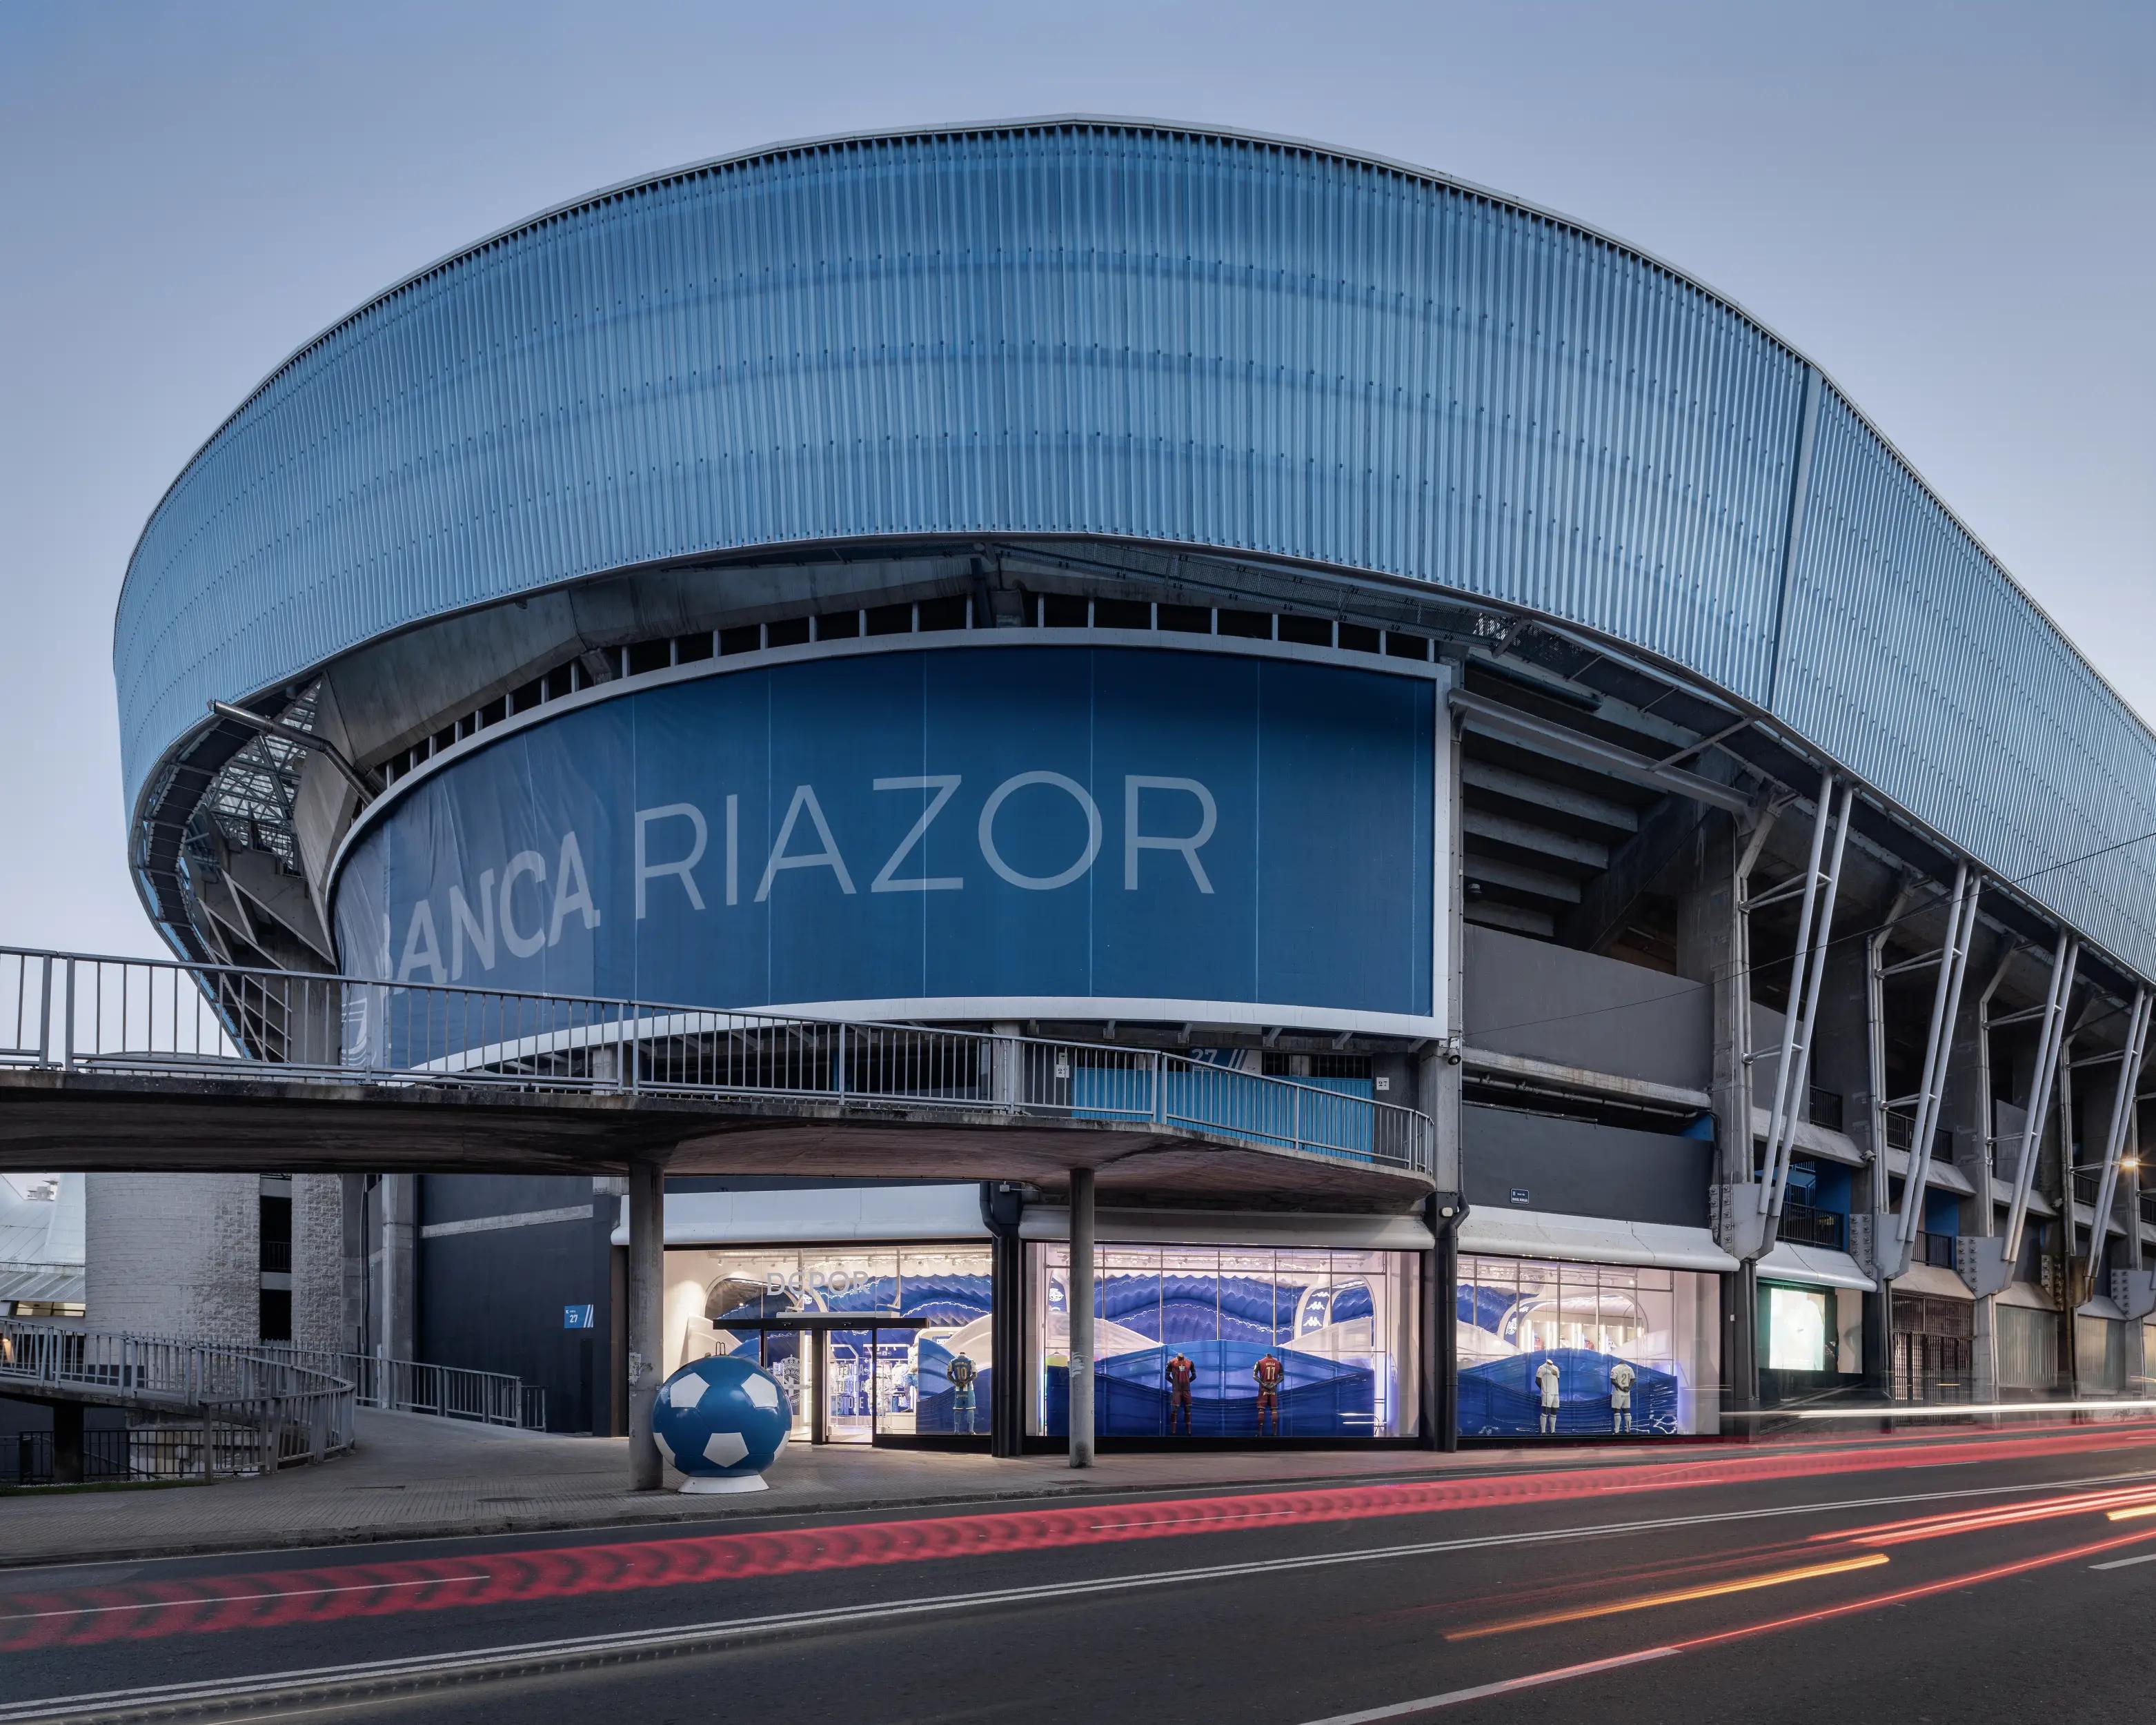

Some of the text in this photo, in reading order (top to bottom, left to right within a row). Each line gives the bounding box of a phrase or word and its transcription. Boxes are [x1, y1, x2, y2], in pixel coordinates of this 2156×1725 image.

[635, 771, 1217, 919] RIAZOR
[1191, 1049, 1218, 1064] 27
[767, 1270, 871, 1296] DEPOR
[569, 1314, 578, 1323] 27
[956, 1367, 967, 1380] 10
[1266, 1366, 1276, 1380] 11
[1621, 1373, 1630, 1385] 21
